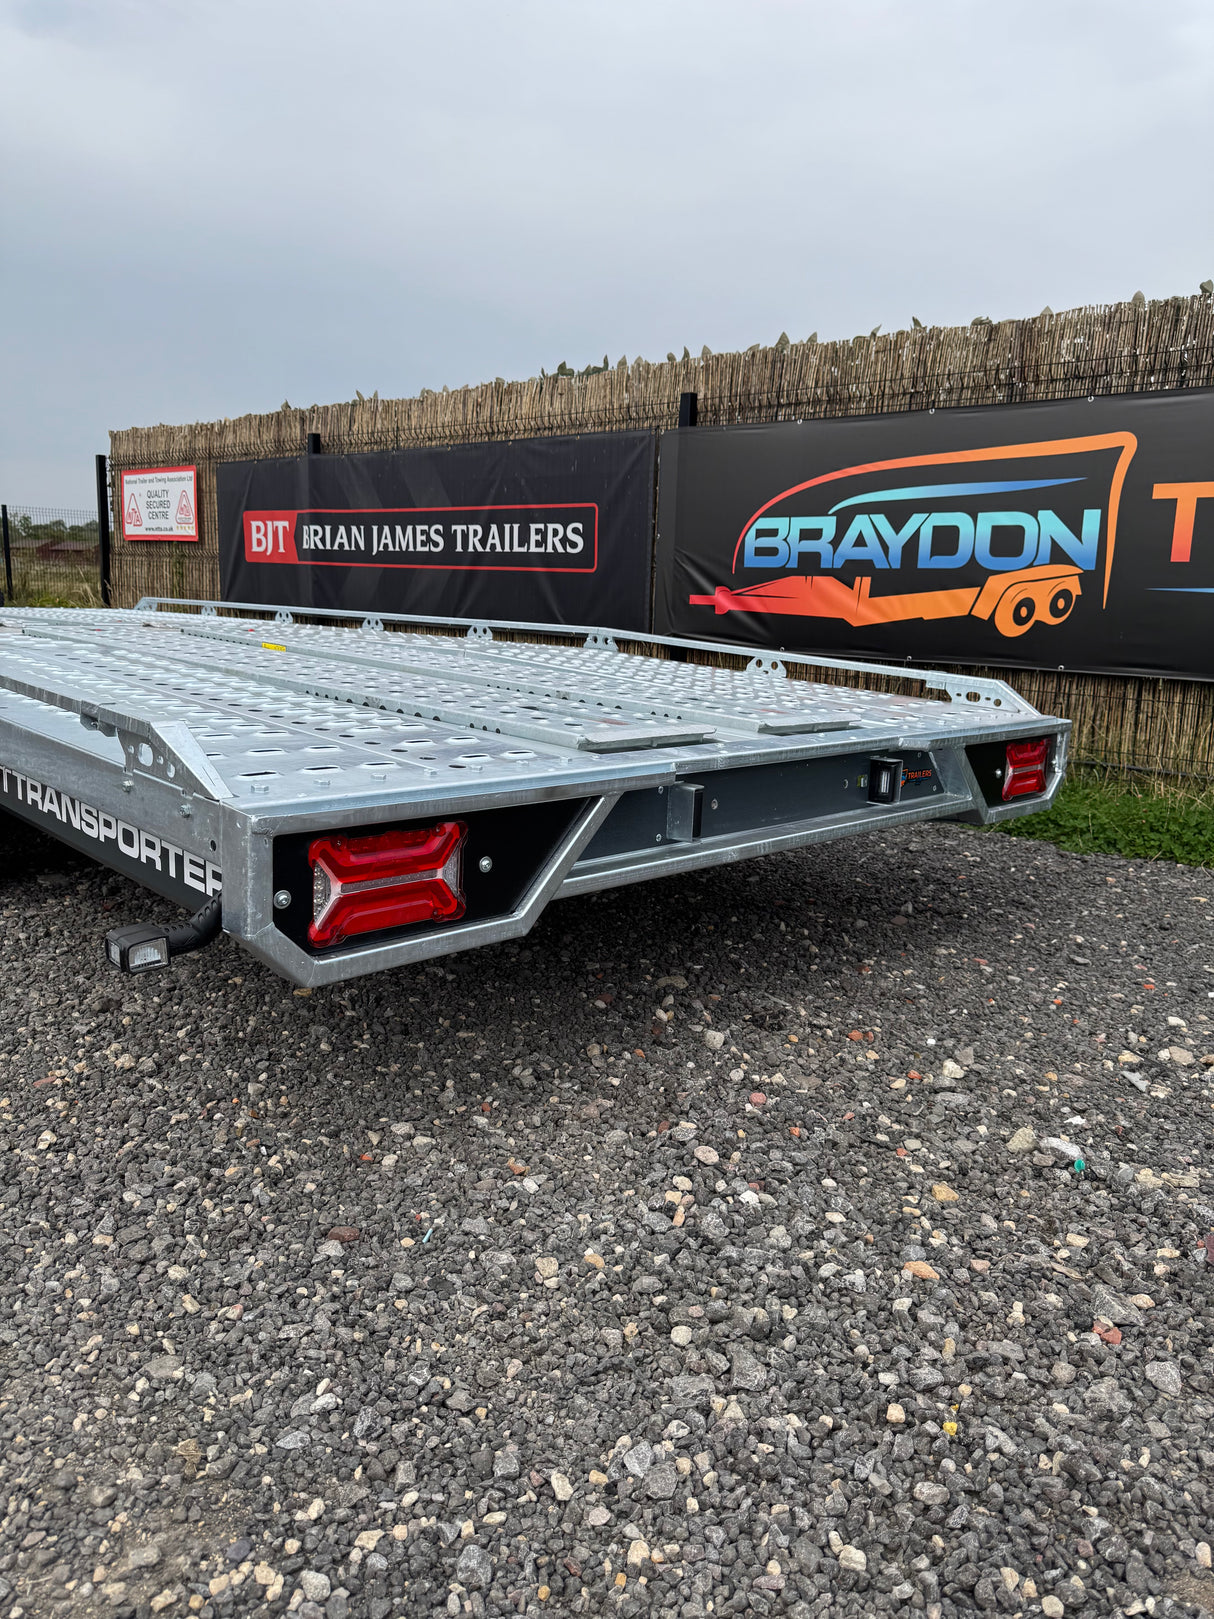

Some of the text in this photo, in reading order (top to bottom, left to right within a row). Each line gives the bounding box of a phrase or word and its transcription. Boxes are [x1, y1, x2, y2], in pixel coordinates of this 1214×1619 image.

[147, 489, 169, 499] QUALITY
[146, 500, 171, 510] SECURED
[148, 511, 169, 520] CENTRE
[1152, 481, 1214, 562] T
[250, 520, 584, 556] BJT BRIAN JAMES TRAILERS
[744, 509, 1101, 571] BRAYDON
[908, 769, 932, 780] TRAILERS
